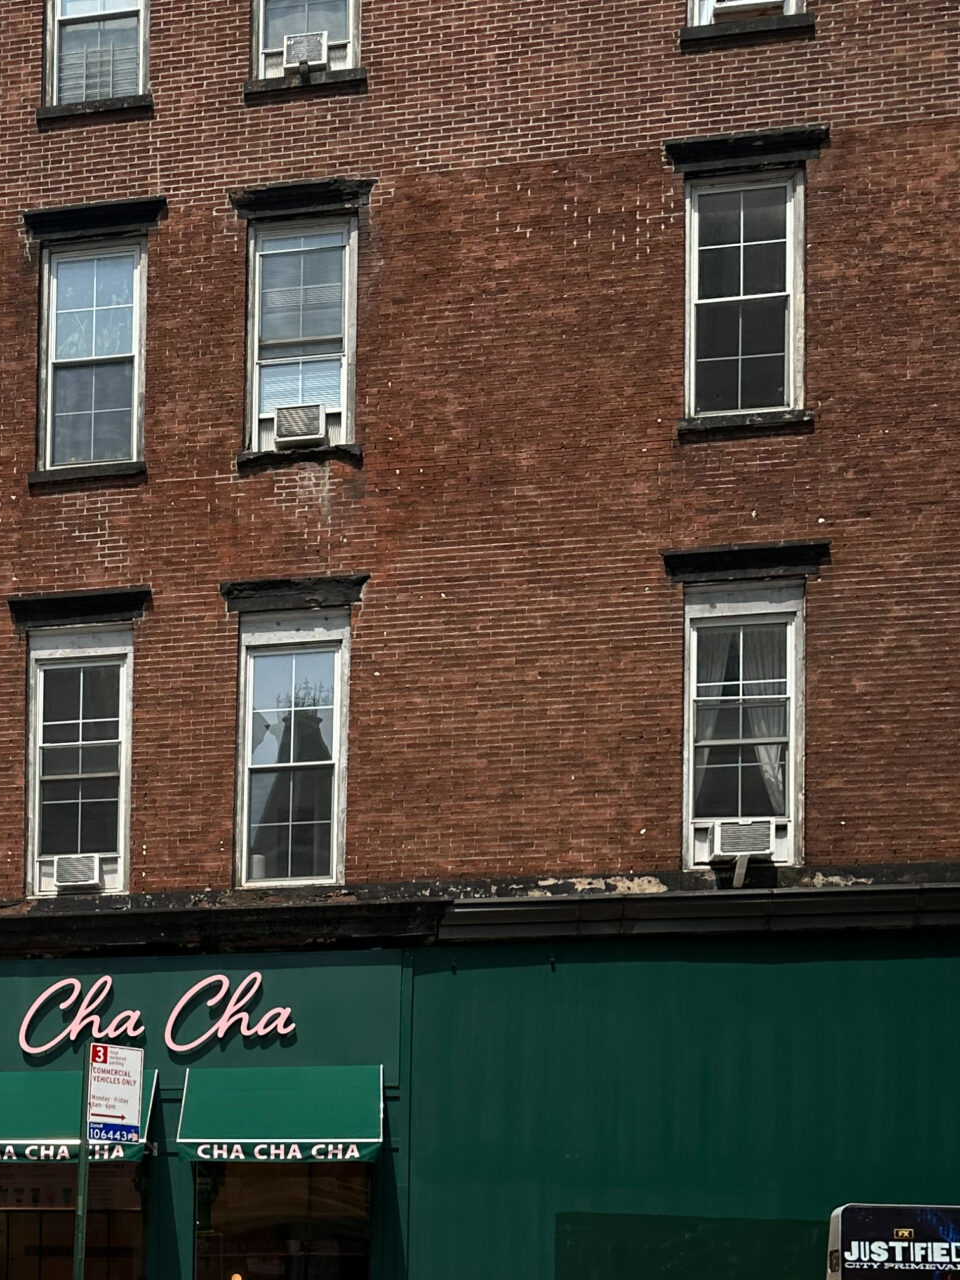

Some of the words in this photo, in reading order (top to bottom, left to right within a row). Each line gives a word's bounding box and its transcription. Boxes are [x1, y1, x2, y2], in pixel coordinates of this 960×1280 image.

[19, 974, 145, 1054] Cha
[164, 971, 296, 1052] Cha
[95, 1046, 105, 1062] 3
[93, 1067, 131, 1077] COMMERCIAL
[93, 1075, 121, 1085] VEHICLES
[122, 1078, 137, 1087] ONLY
[90, 1128, 127, 1141] 106443
[24, 1144, 71, 1160] CHA
[88, 1144, 125, 1160] HA
[197, 1143, 246, 1159] CHA
[253, 1143, 303, 1160] CHA
[311, 1143, 360, 1159] CHA
[883, 1262, 960, 1271] PRIMEVA
